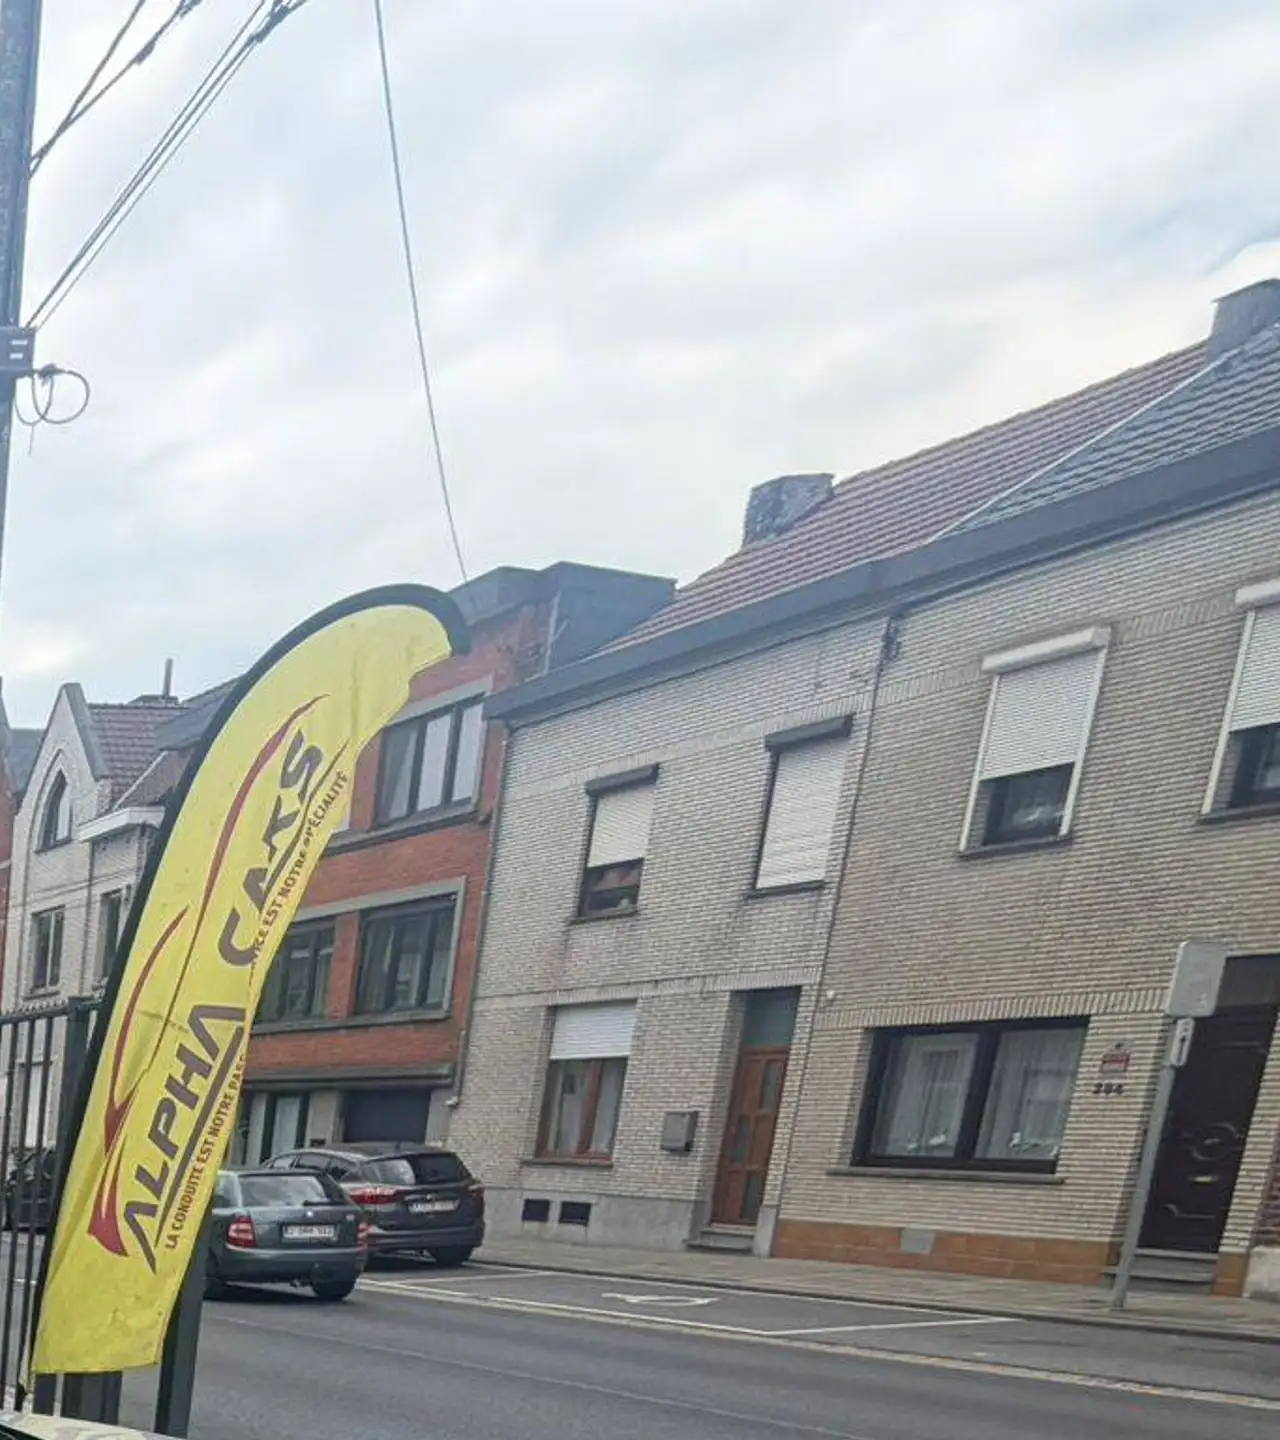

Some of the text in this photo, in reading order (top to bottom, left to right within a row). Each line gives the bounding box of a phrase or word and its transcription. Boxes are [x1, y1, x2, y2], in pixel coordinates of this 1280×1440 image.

[123, 1004, 247, 1275] ALPHA
[208, 1090, 234, 1141] NOTRE
[197, 1136, 216, 1166] EST
[171, 1163, 204, 1232] CONDUITE
[165, 1229, 178, 1250] LA
